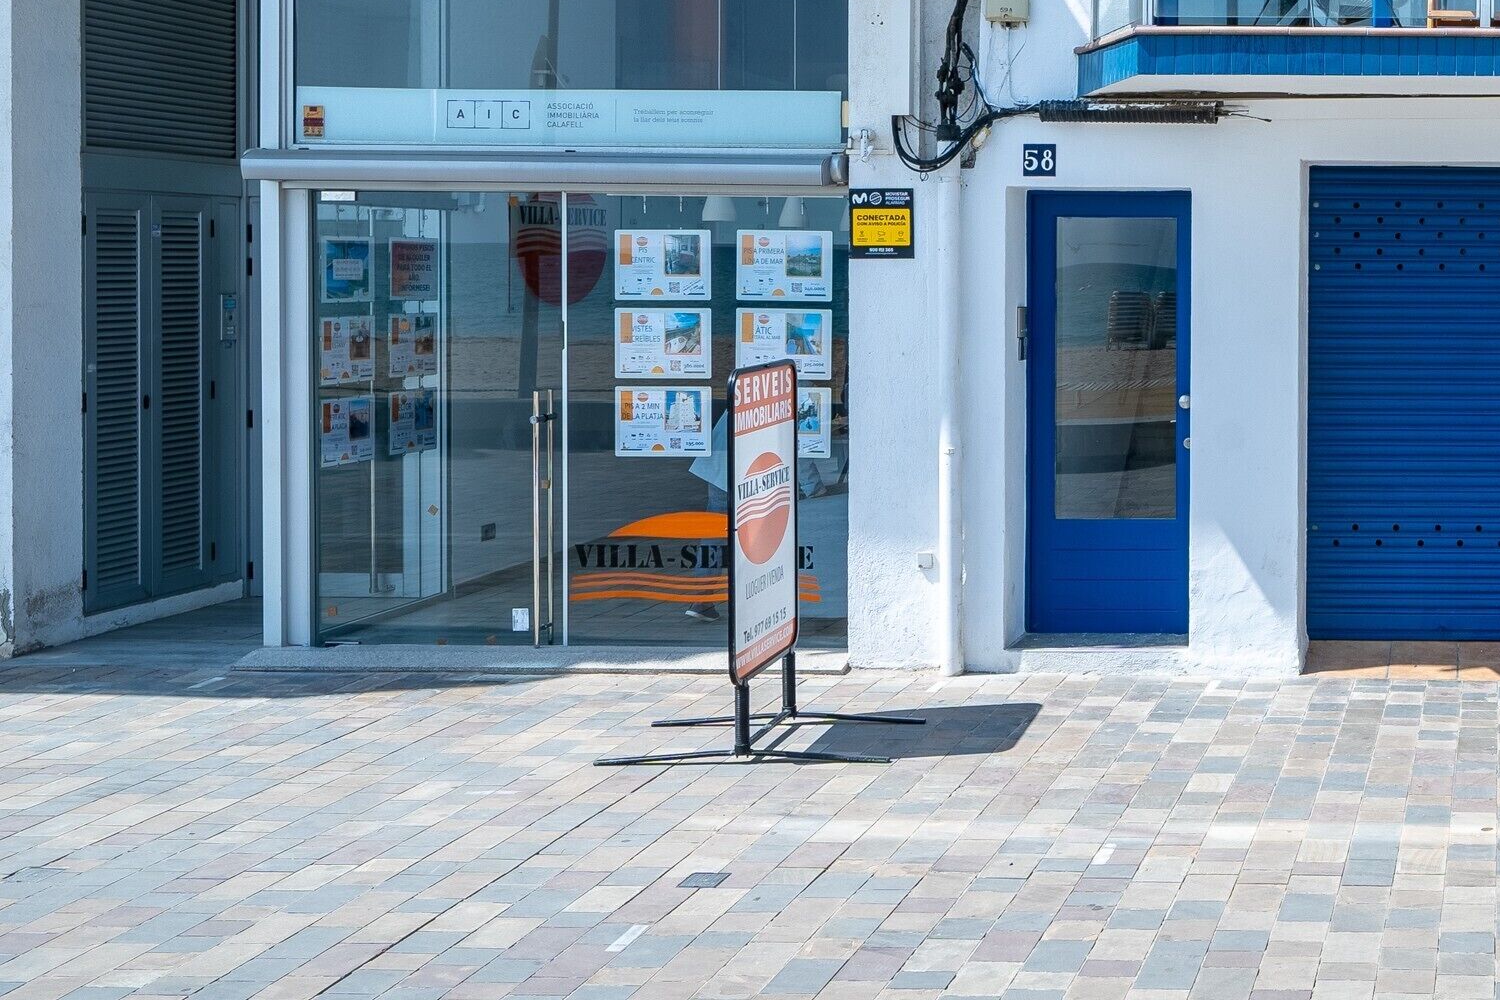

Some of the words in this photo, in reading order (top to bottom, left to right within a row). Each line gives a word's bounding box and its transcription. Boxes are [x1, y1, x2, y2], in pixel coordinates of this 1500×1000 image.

[547, 102, 594, 110] ASSOCIACIÓ
[547, 120, 584, 128] CALAFELL
[1024, 149, 1054, 171] 58
[519, 205, 607, 226] VILLA-ERVICE
[735, 368, 792, 407] SERVEIS
[735, 398, 792, 433] IMMOBILIARIS
[738, 466, 790, 500] VILLA-SERVICE
[575, 544, 814, 569] VILLA-SEE
[743, 627, 753, 644] Tel.
